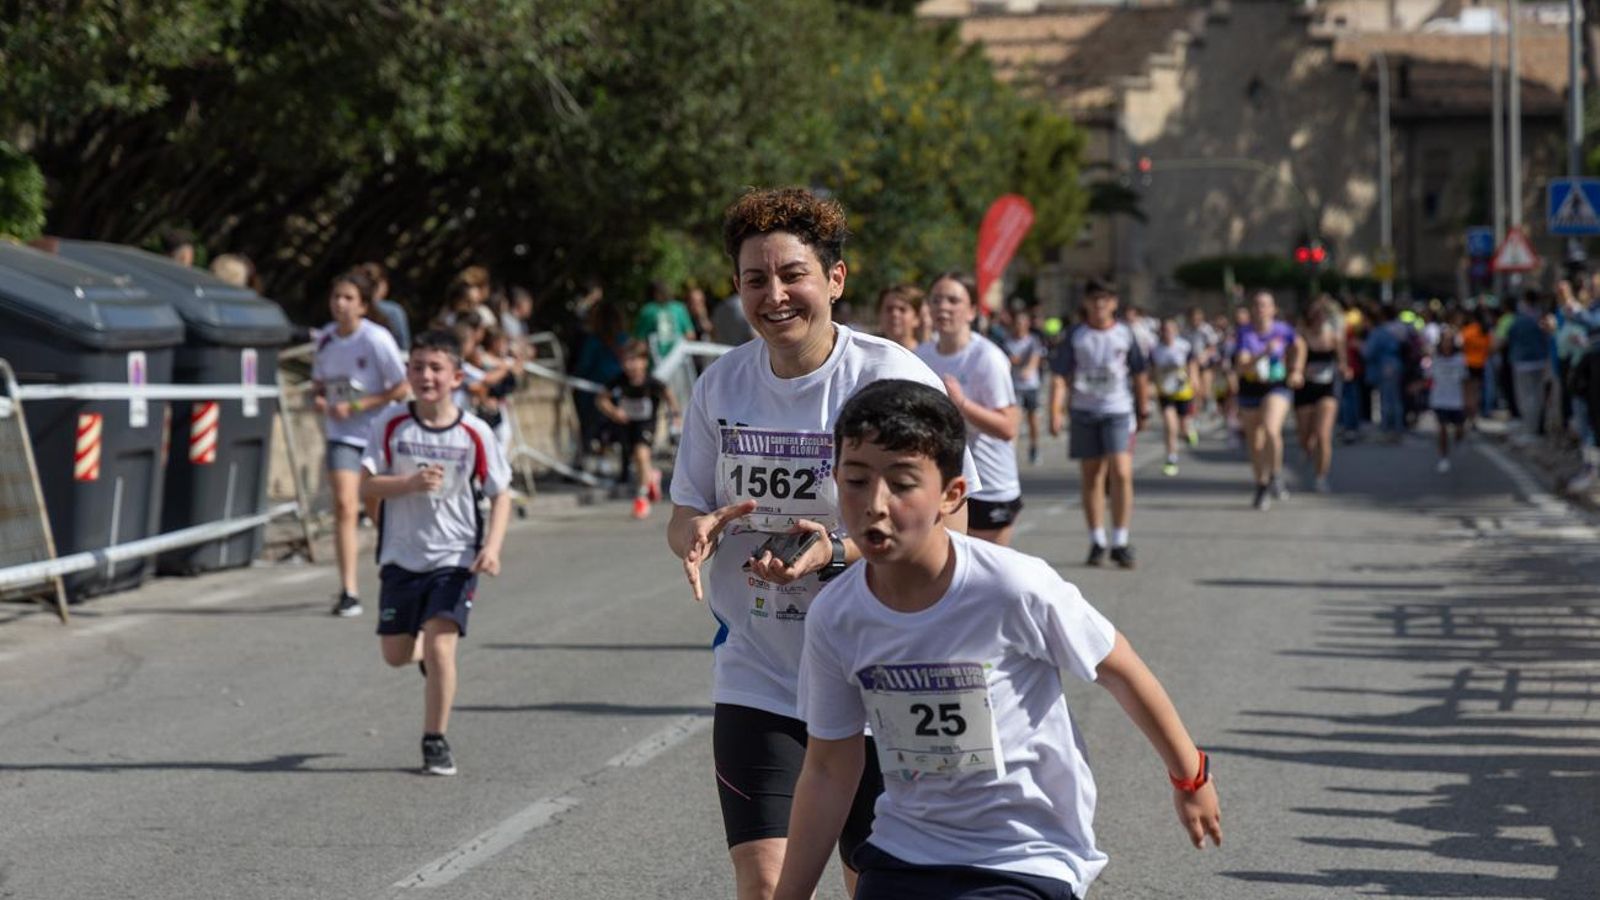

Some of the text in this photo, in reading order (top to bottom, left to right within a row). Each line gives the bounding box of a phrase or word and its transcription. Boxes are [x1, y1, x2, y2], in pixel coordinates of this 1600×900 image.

[771, 436, 798, 445] CARRERA
[800, 438, 829, 447] ESCOLAR
[775, 445, 820, 456] LA GLORIA
[730, 464, 816, 500] 1562
[910, 703, 967, 737] 25
